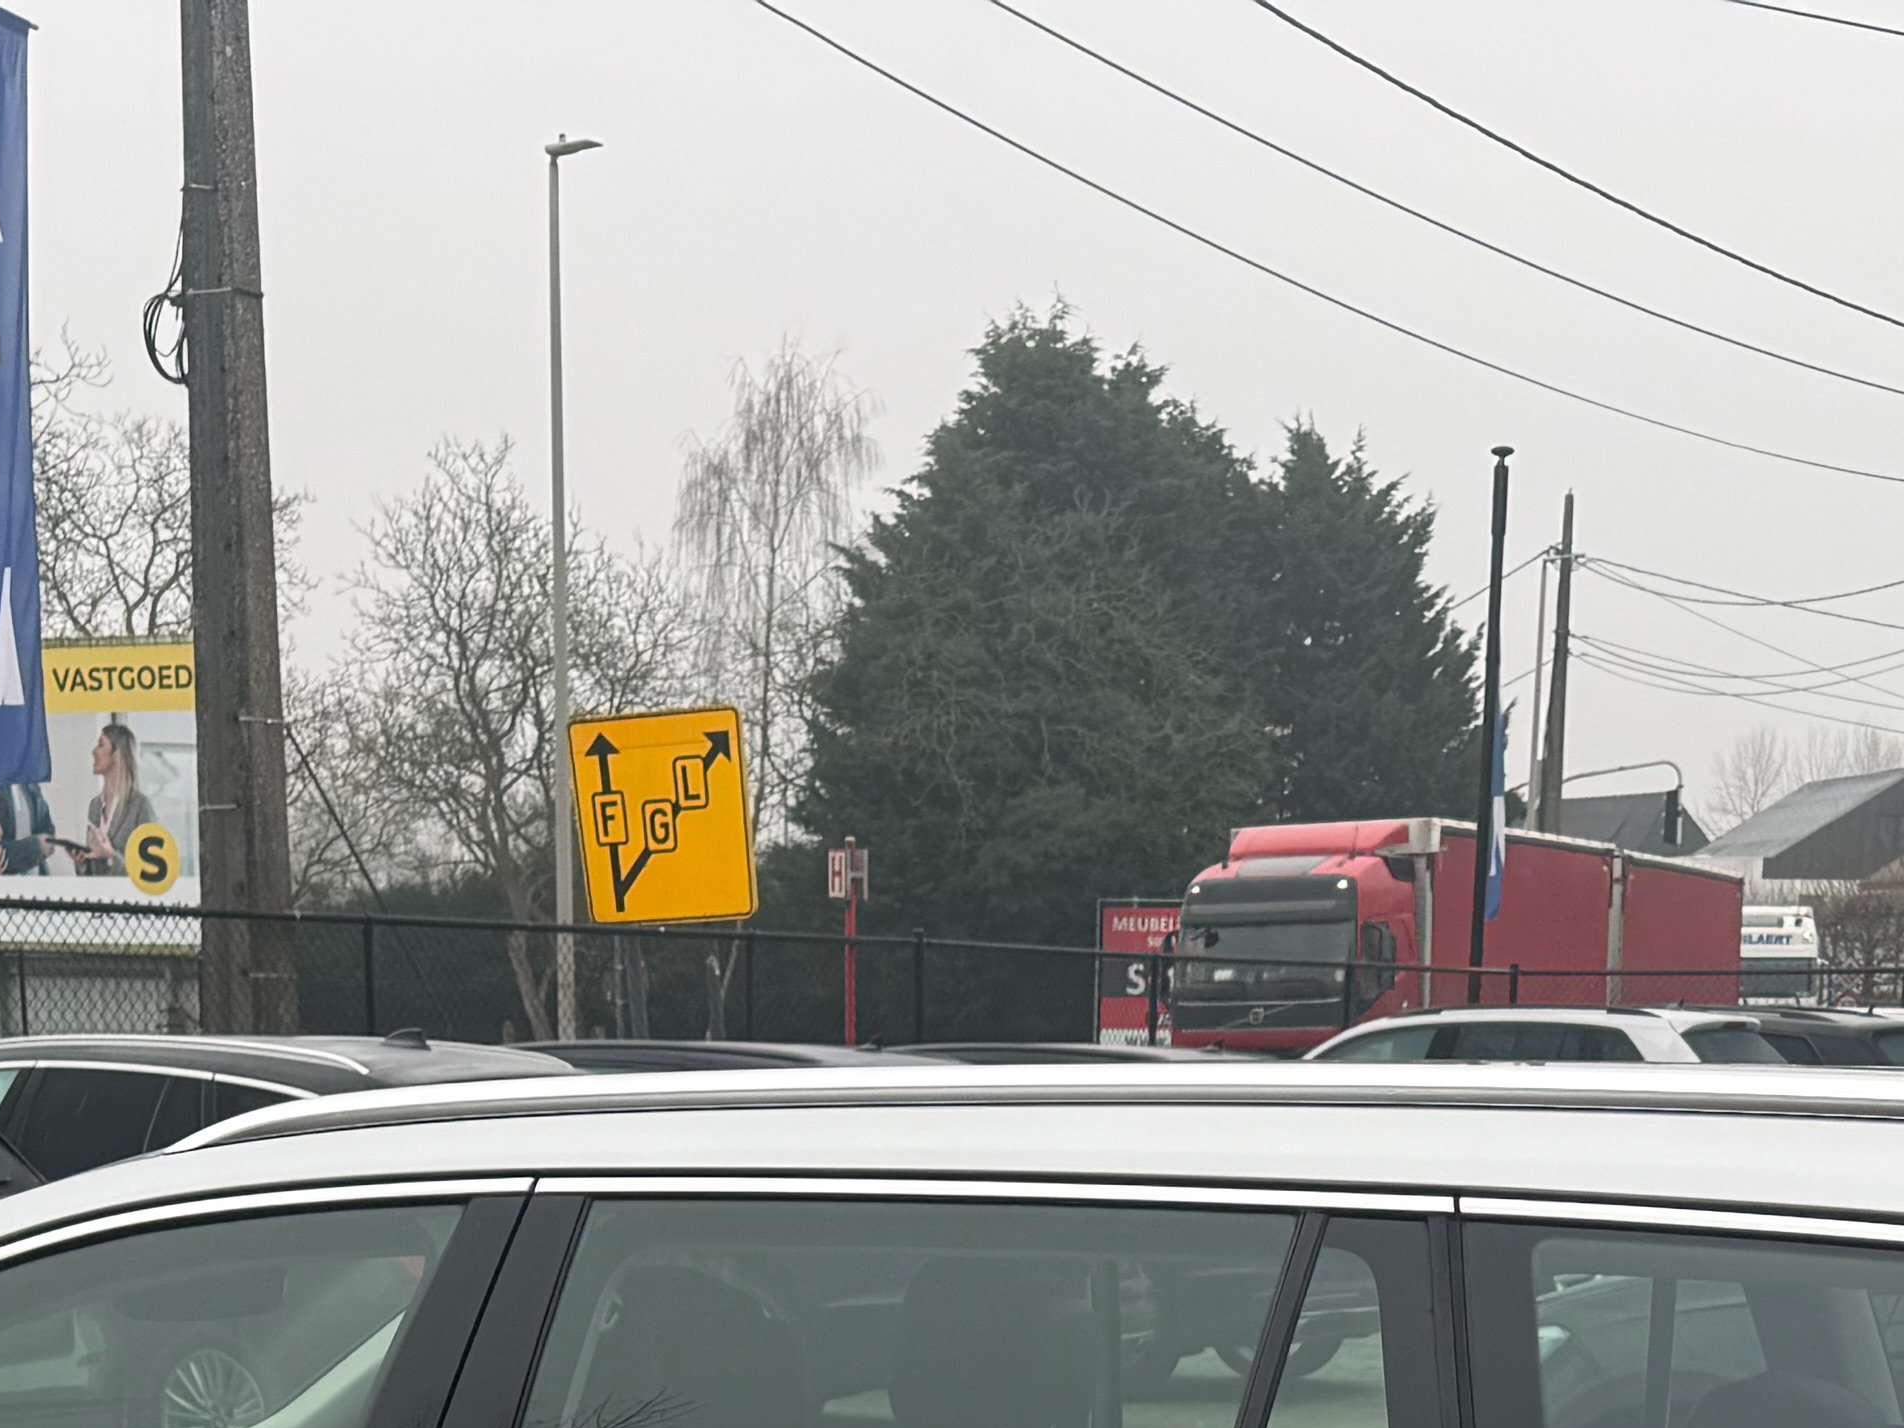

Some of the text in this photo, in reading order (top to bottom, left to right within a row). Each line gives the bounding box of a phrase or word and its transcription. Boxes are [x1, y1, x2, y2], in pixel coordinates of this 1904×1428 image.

[52, 664, 193, 692] VASTGOED
[681, 765, 701, 801] L
[600, 801, 618, 838] F
[650, 808, 670, 845] G
[137, 836, 168, 882] S
